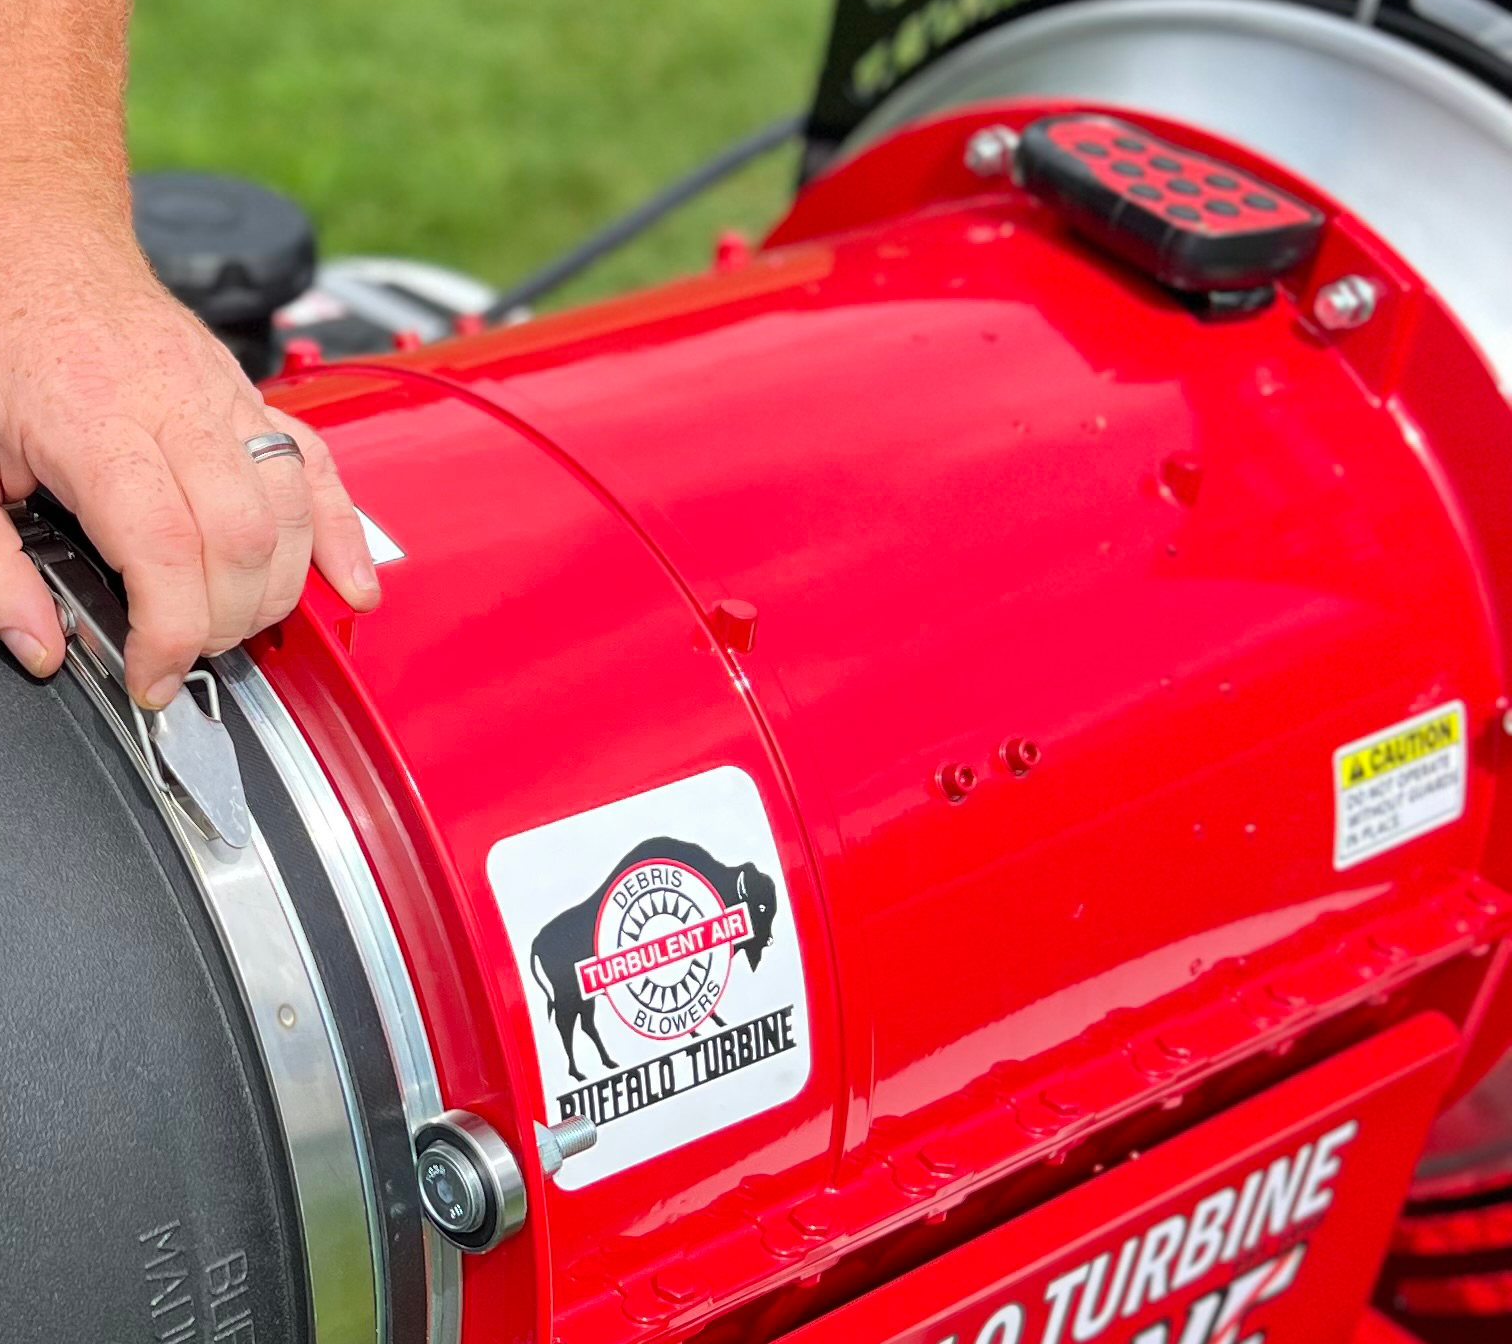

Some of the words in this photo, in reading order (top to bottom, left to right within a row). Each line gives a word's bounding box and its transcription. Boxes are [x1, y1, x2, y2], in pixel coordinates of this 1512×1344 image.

[1370, 716, 1452, 773] CAUTION
[1369, 776, 1394, 798] NOT
[1397, 752, 1450, 788] OPERATE
[1348, 791, 1404, 827] WITHOUT
[1361, 812, 1400, 839] PLACE
[612, 867, 683, 910] DEBRIS
[584, 931, 705, 989] TURBULENT
[711, 914, 746, 946] AIR
[633, 980, 720, 1035] BLOWERS
[556, 1055, 676, 1127] BUFFALO
[686, 1003, 798, 1087] TURBINE
